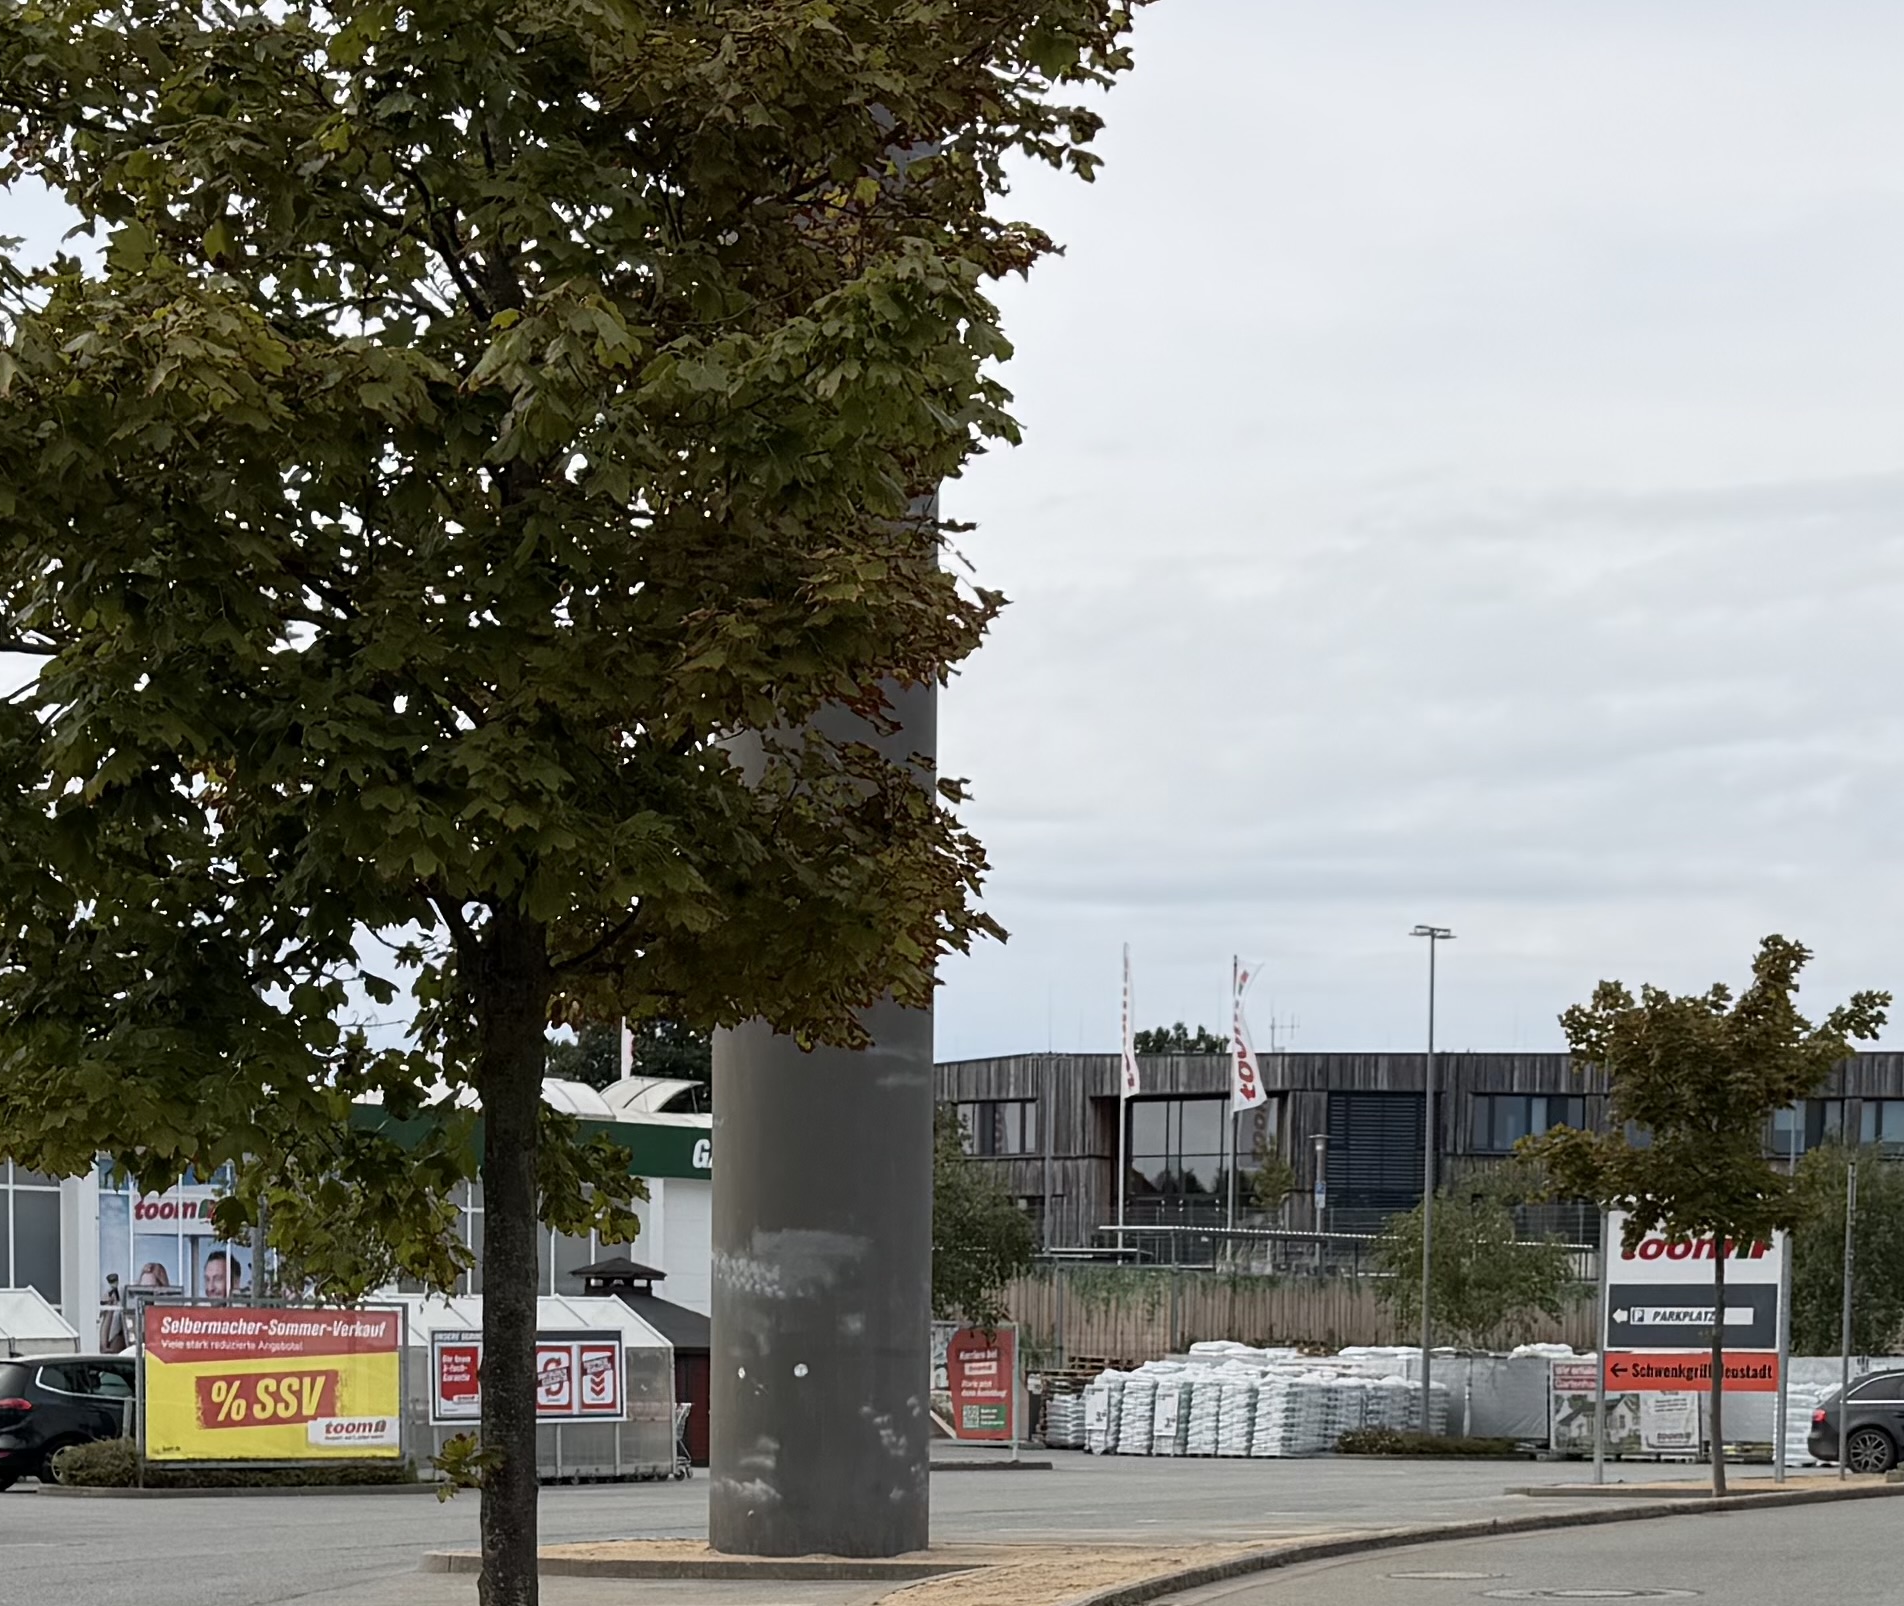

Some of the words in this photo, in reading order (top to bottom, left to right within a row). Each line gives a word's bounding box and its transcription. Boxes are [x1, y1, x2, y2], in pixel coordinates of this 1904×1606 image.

[134, 1200, 200, 1221] toom
[1652, 1310, 1717, 1322] PARKPLATZ
[160, 1317, 386, 1339] Selbermacher-Sommer-Verkauf
[1722, 1363, 1773, 1380] eustadt
[252, 1375, 326, 1420] SSV
[325, 1421, 373, 1434] toom
